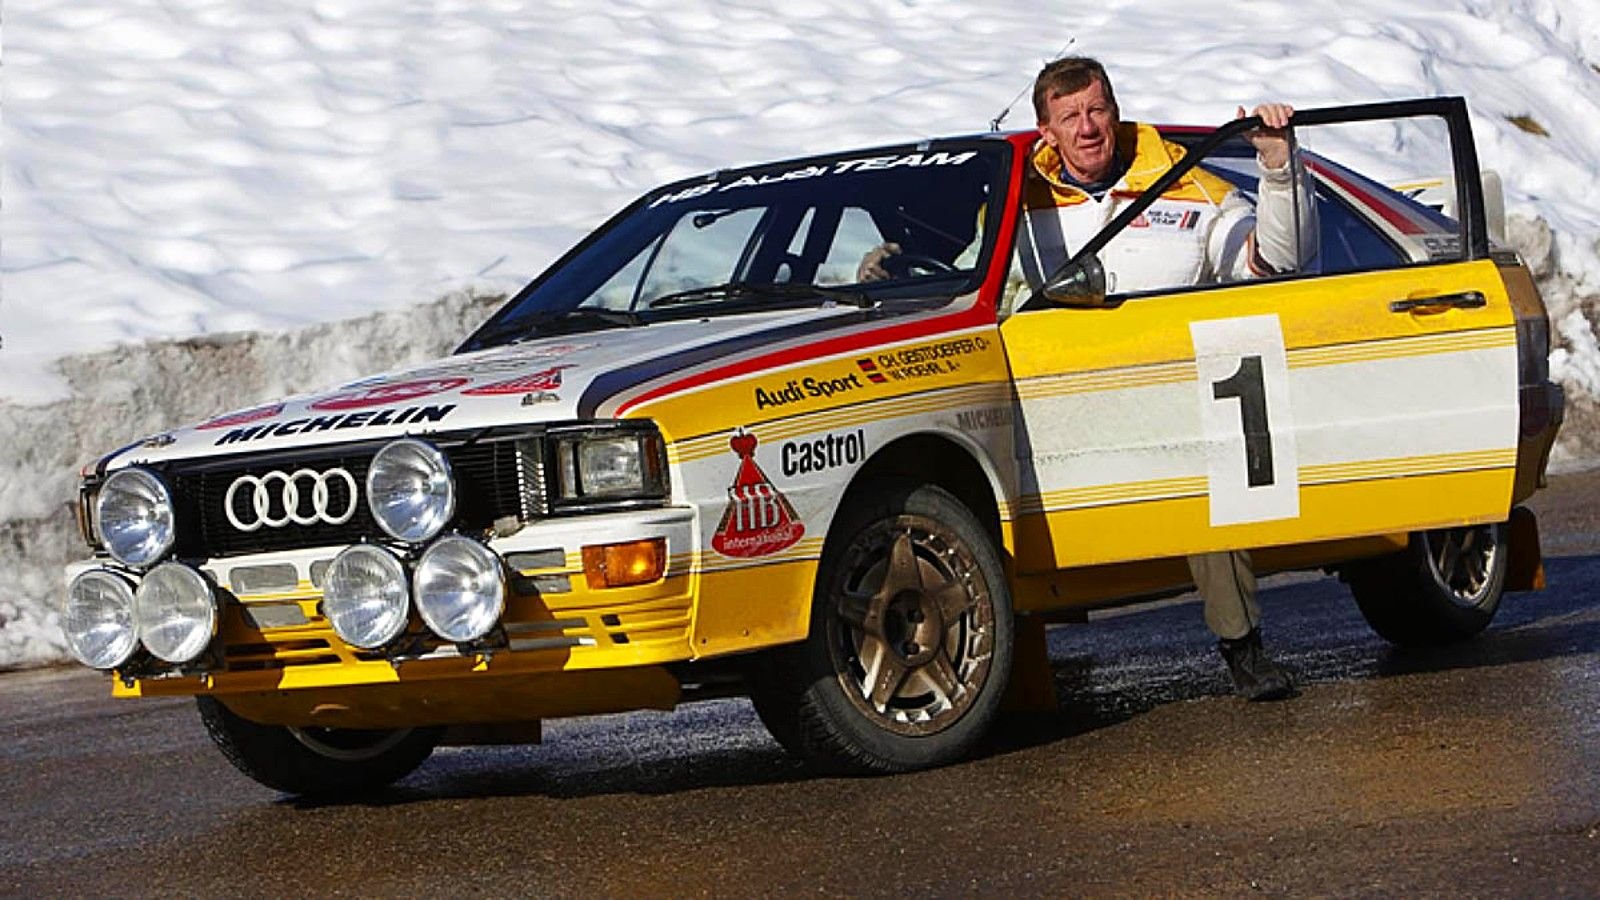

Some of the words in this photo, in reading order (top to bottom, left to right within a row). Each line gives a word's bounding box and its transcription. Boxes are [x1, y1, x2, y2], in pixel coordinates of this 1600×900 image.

[832, 151, 978, 174] TEAM
[754, 380, 806, 411] Audi
[802, 372, 864, 398] Sport
[214, 404, 458, 447] MICHELIN
[1211, 354, 1276, 489] 1
[781, 428, 866, 478] Castrol
